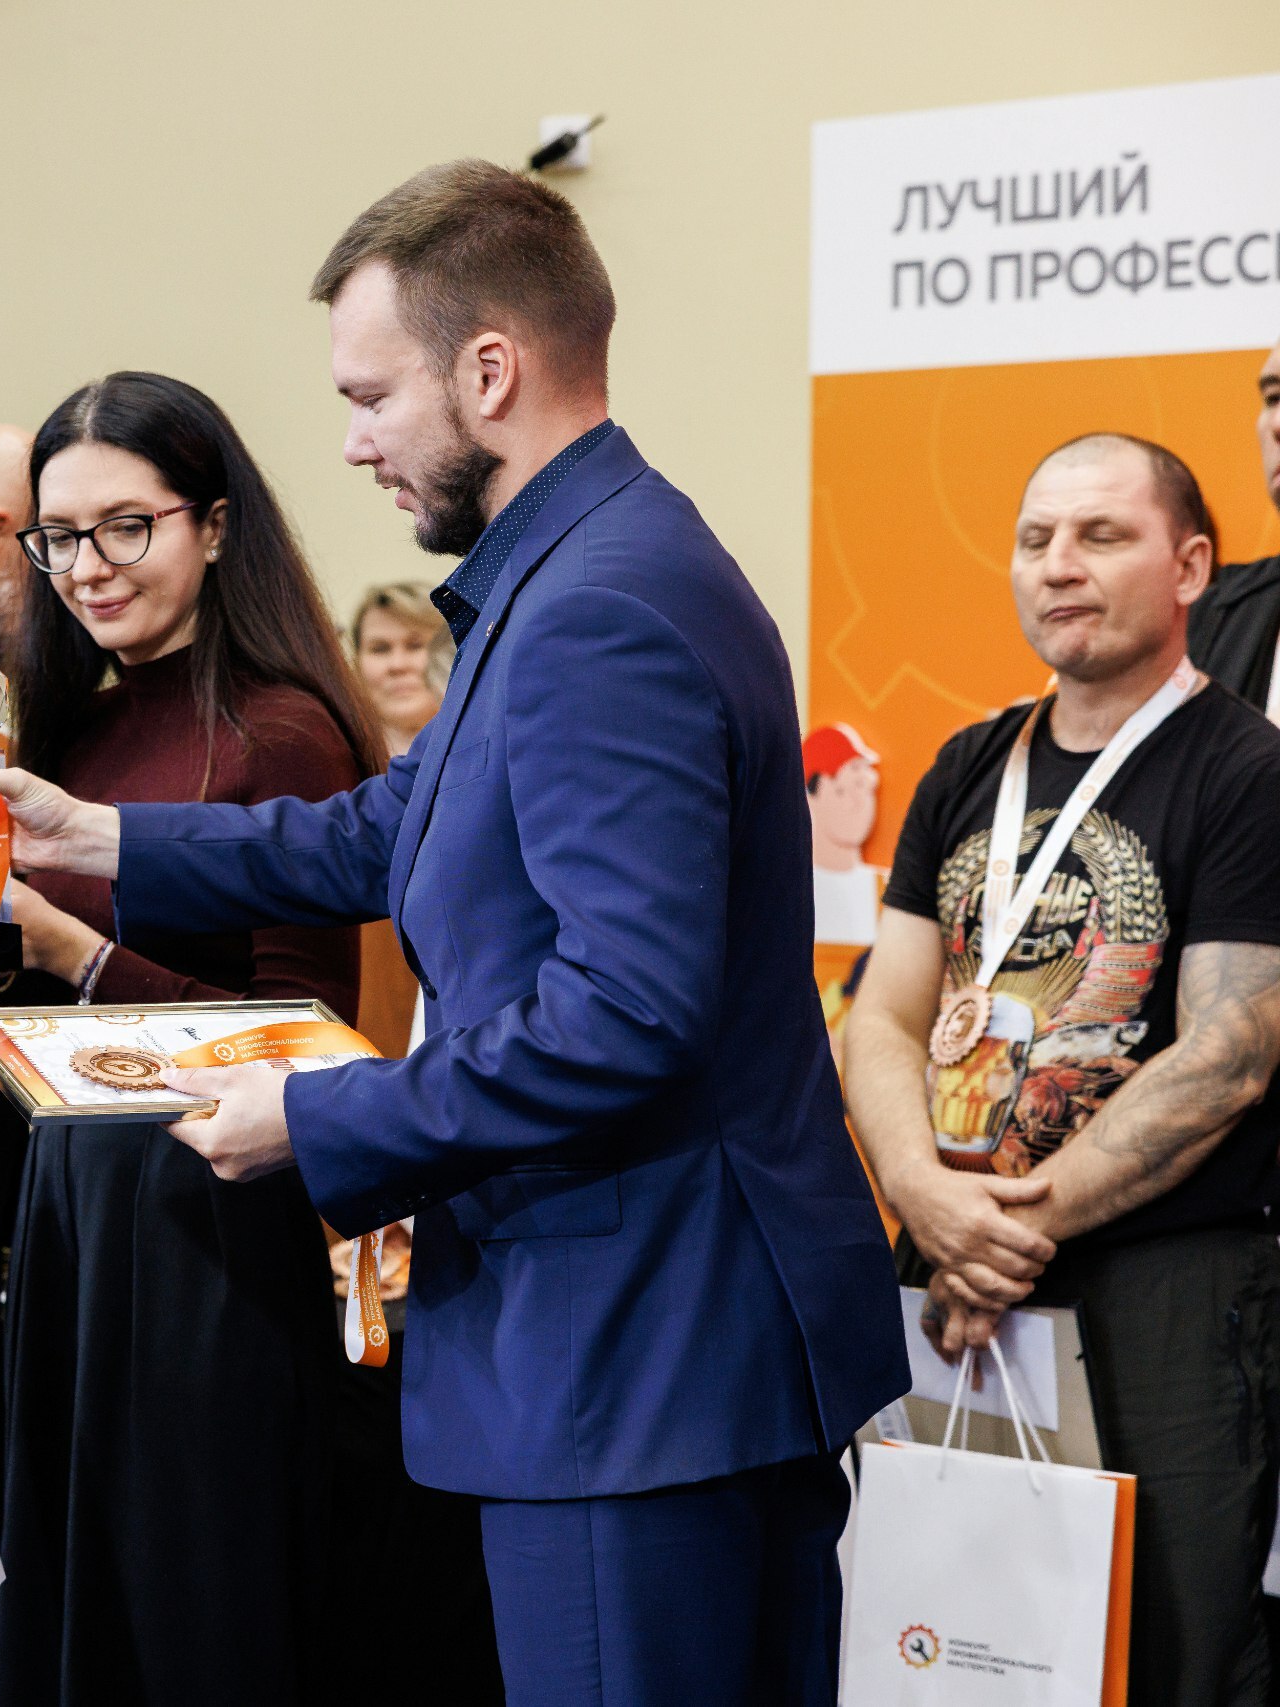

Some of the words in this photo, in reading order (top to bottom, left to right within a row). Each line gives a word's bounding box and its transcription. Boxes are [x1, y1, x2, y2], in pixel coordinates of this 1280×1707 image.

[893, 151, 1149, 234] ЛУЧШИЙ
[892, 257, 970, 309] ПО
[989, 233, 1280, 302] ПРОФЕСС
[235, 1033, 266, 1045] КОНКУРС
[237, 1037, 314, 1052] ПРОФЕССИОНАЛЬНОГО
[240, 1048, 280, 1059] МАСТЕРСТВА
